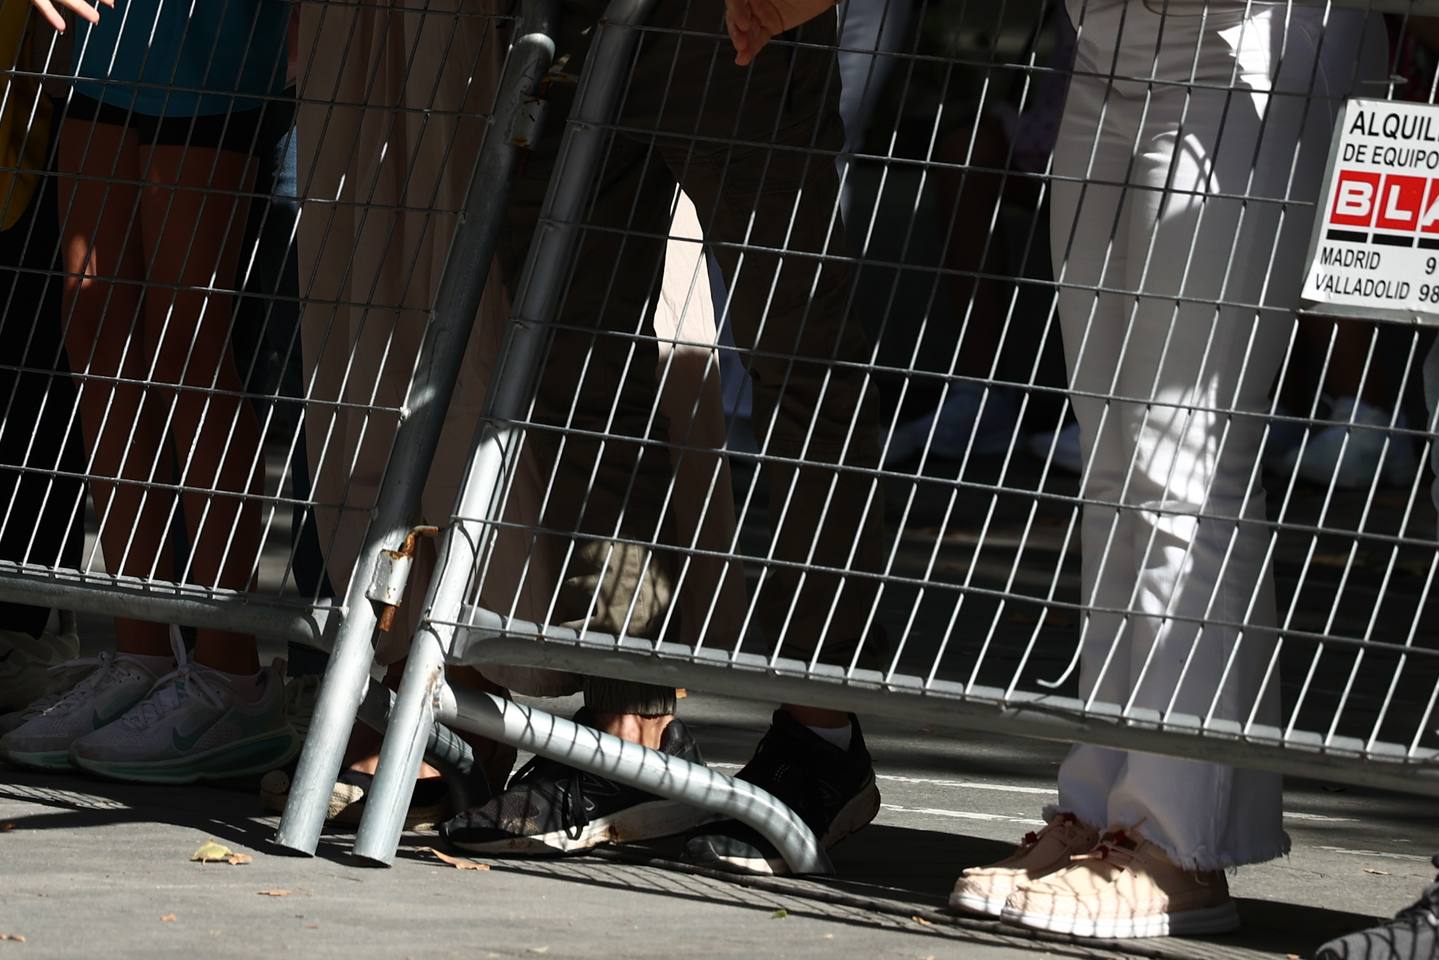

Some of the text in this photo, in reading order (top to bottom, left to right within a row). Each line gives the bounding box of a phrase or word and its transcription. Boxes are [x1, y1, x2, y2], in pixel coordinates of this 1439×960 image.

[1349, 110, 1439, 142] ALQUIL
[1343, 143, 1367, 163] DE
[1320, 247, 1381, 270] MADRID
[1315, 273, 1410, 300] VALLADOLID
